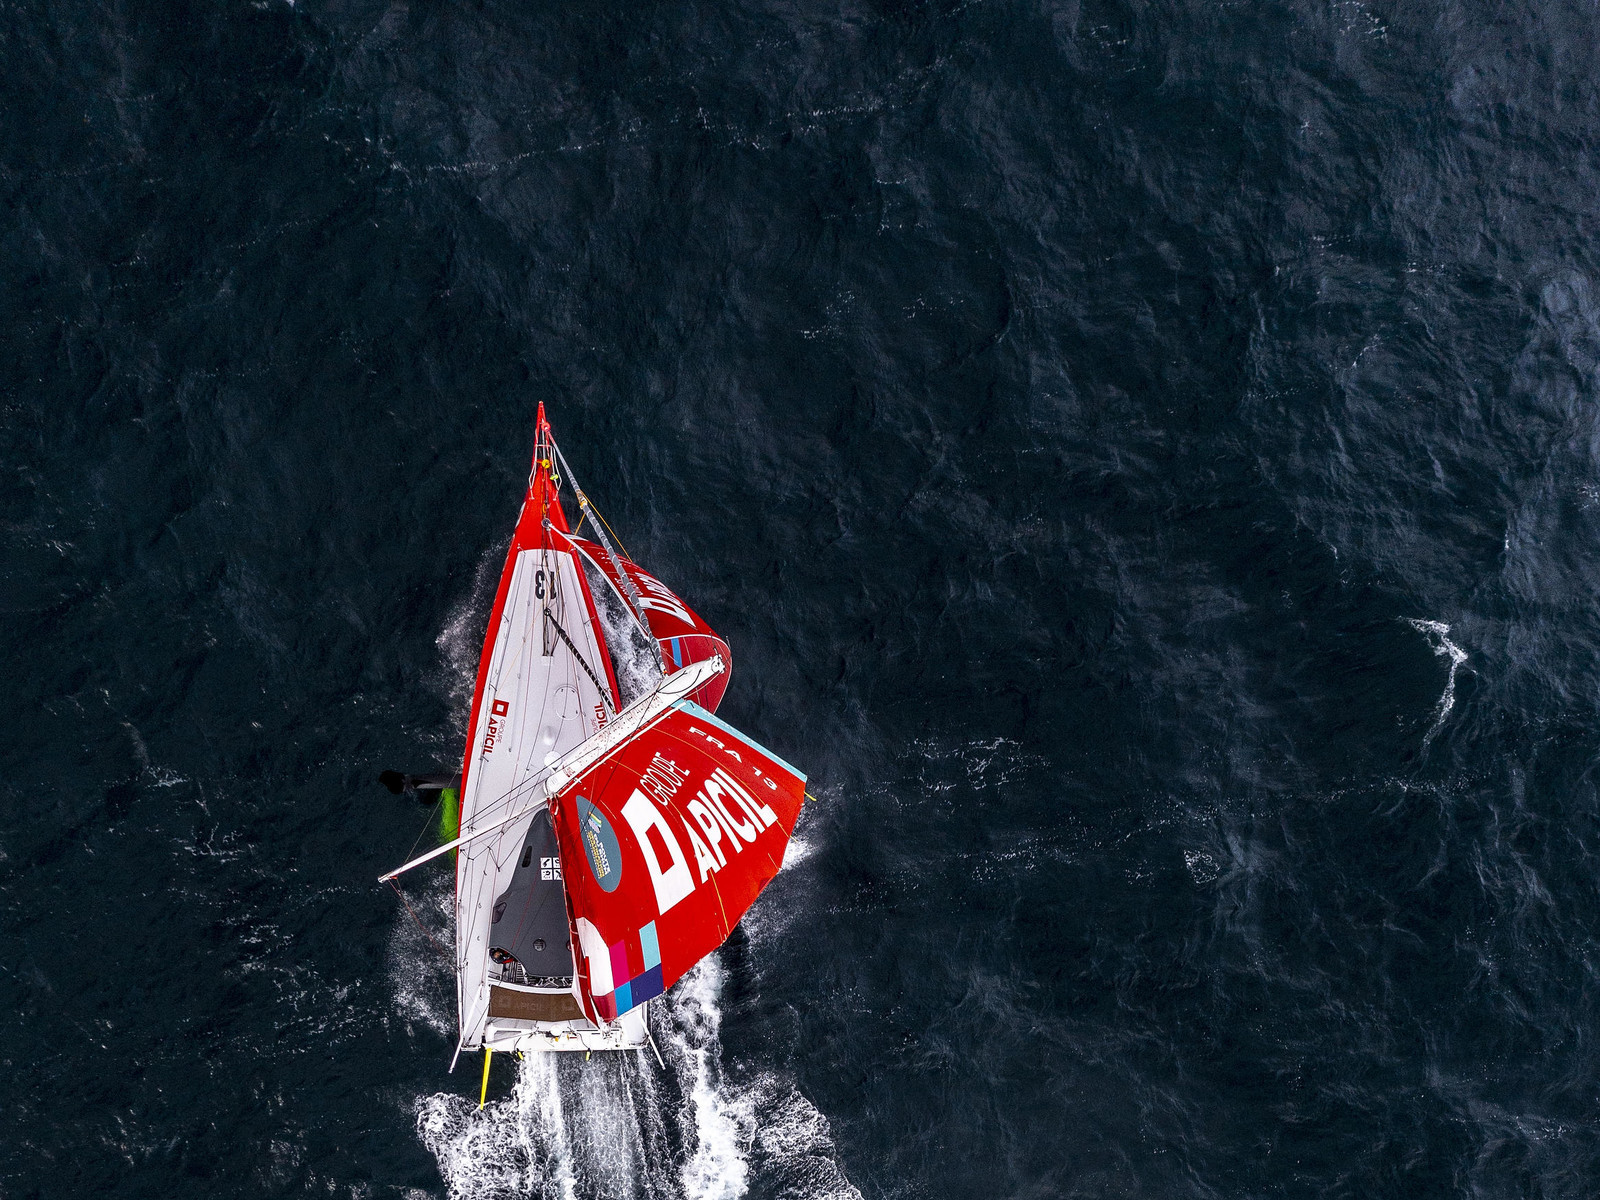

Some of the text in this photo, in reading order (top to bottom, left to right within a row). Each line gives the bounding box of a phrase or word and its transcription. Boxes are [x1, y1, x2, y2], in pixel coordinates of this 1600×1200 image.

[482, 716, 498, 755] APICIL
[689, 726, 742, 763] FRA
[752, 766, 778, 791] 13
[640, 751, 690, 806] GROUPE
[680, 767, 778, 884] APICIL
